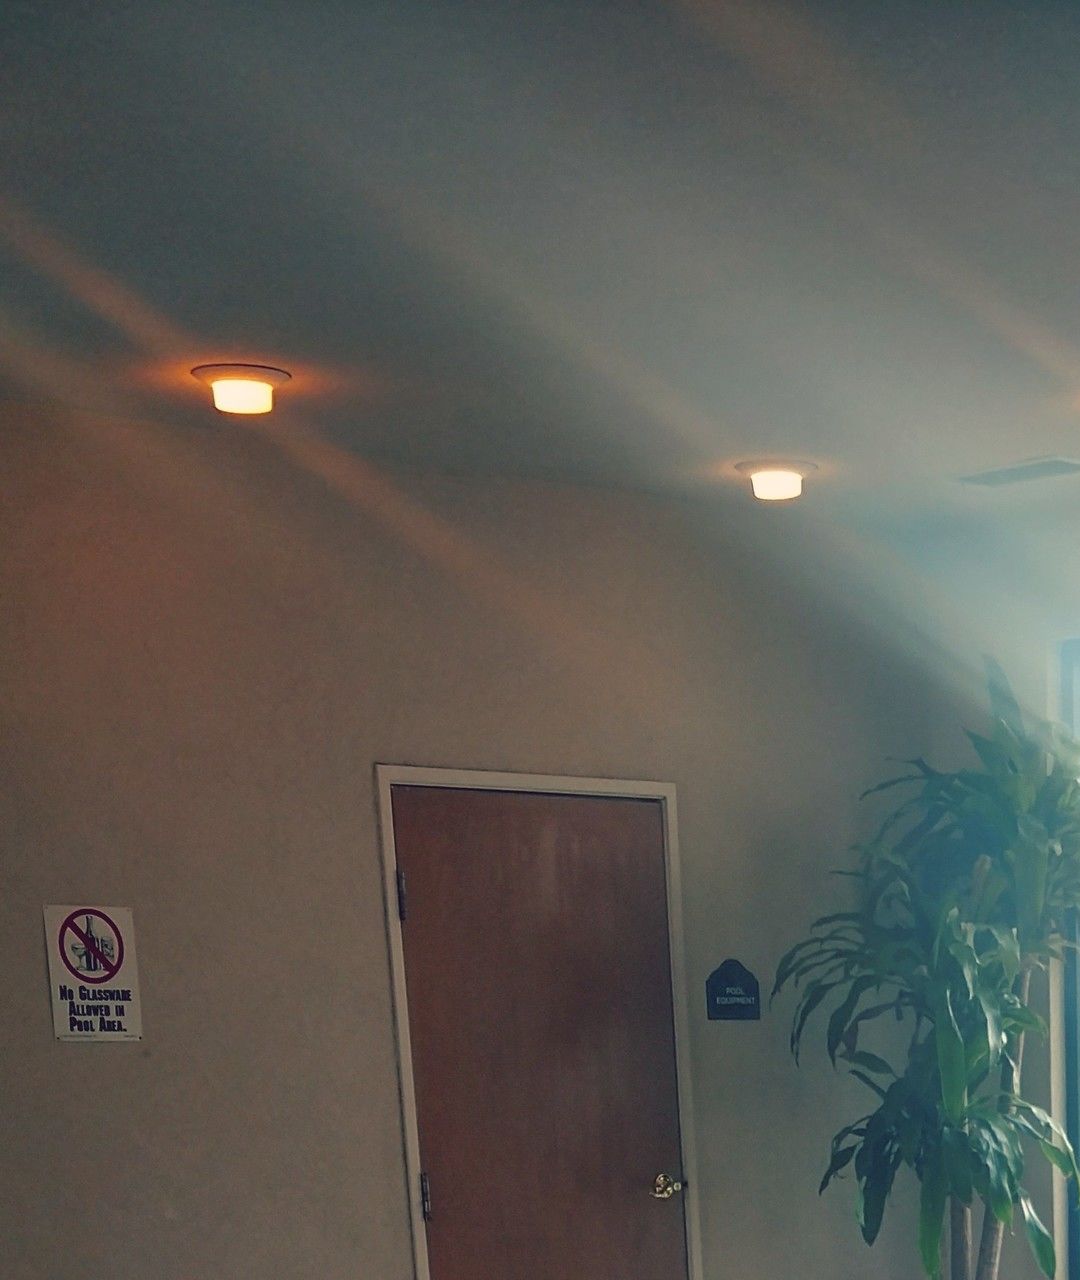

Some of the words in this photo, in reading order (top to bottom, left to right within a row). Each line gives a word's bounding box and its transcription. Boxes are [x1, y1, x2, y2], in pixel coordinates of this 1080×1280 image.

[59, 985, 74, 1000] NO
[79, 985, 132, 1001] GLASSWARE
[69, 1001, 110, 1016] ALLOWED
[69, 1017, 95, 1031] POOL
